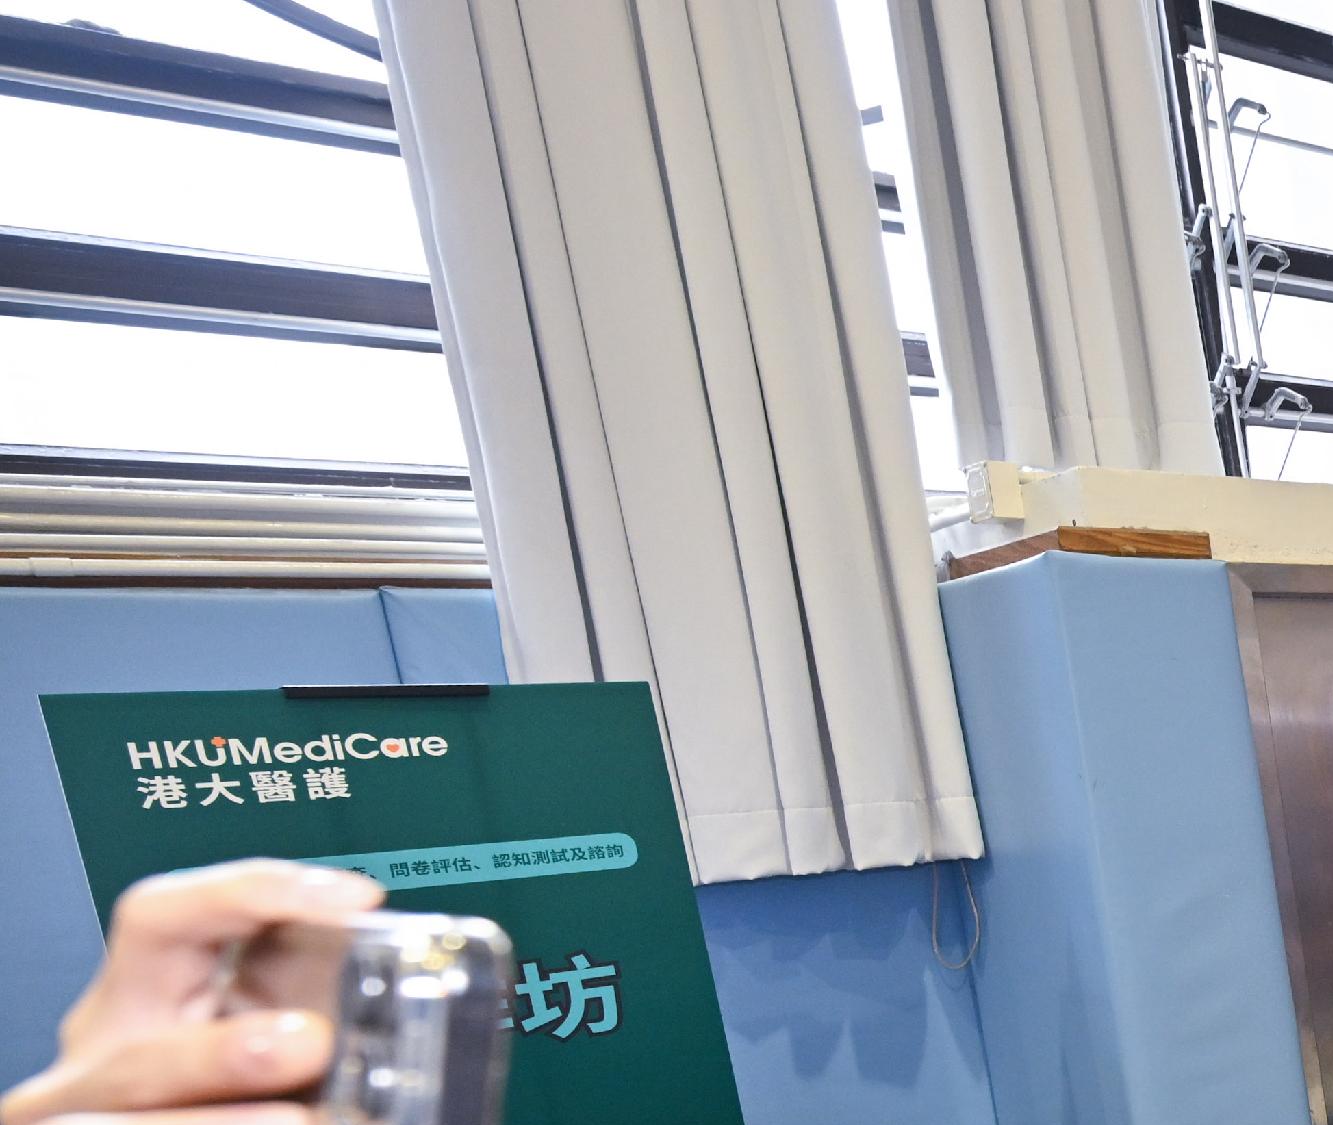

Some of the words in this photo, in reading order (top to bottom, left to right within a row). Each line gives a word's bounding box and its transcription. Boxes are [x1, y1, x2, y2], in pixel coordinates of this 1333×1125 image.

[127, 733, 448, 770] HKUMediCare
[137, 767, 351, 809] 港大醫護
